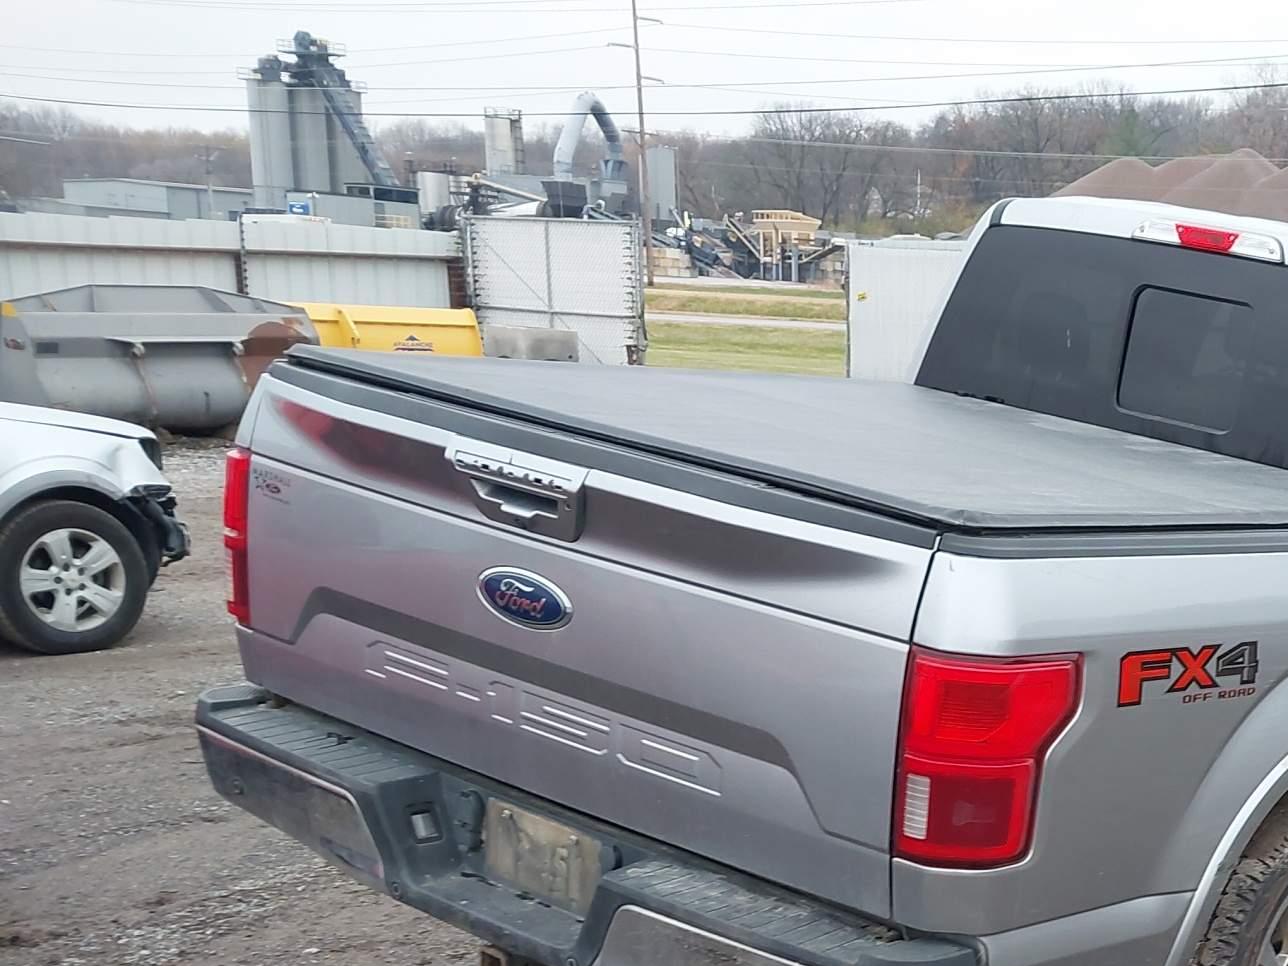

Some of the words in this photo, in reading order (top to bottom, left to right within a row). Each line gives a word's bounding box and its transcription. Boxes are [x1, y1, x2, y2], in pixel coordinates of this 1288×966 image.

[496, 578, 546, 618] Ford
[1117, 641, 1258, 707] FX4
[1182, 692, 1213, 704] OFF
[1217, 687, 1256, 699] ROAD
[364, 640, 723, 796] F-150
